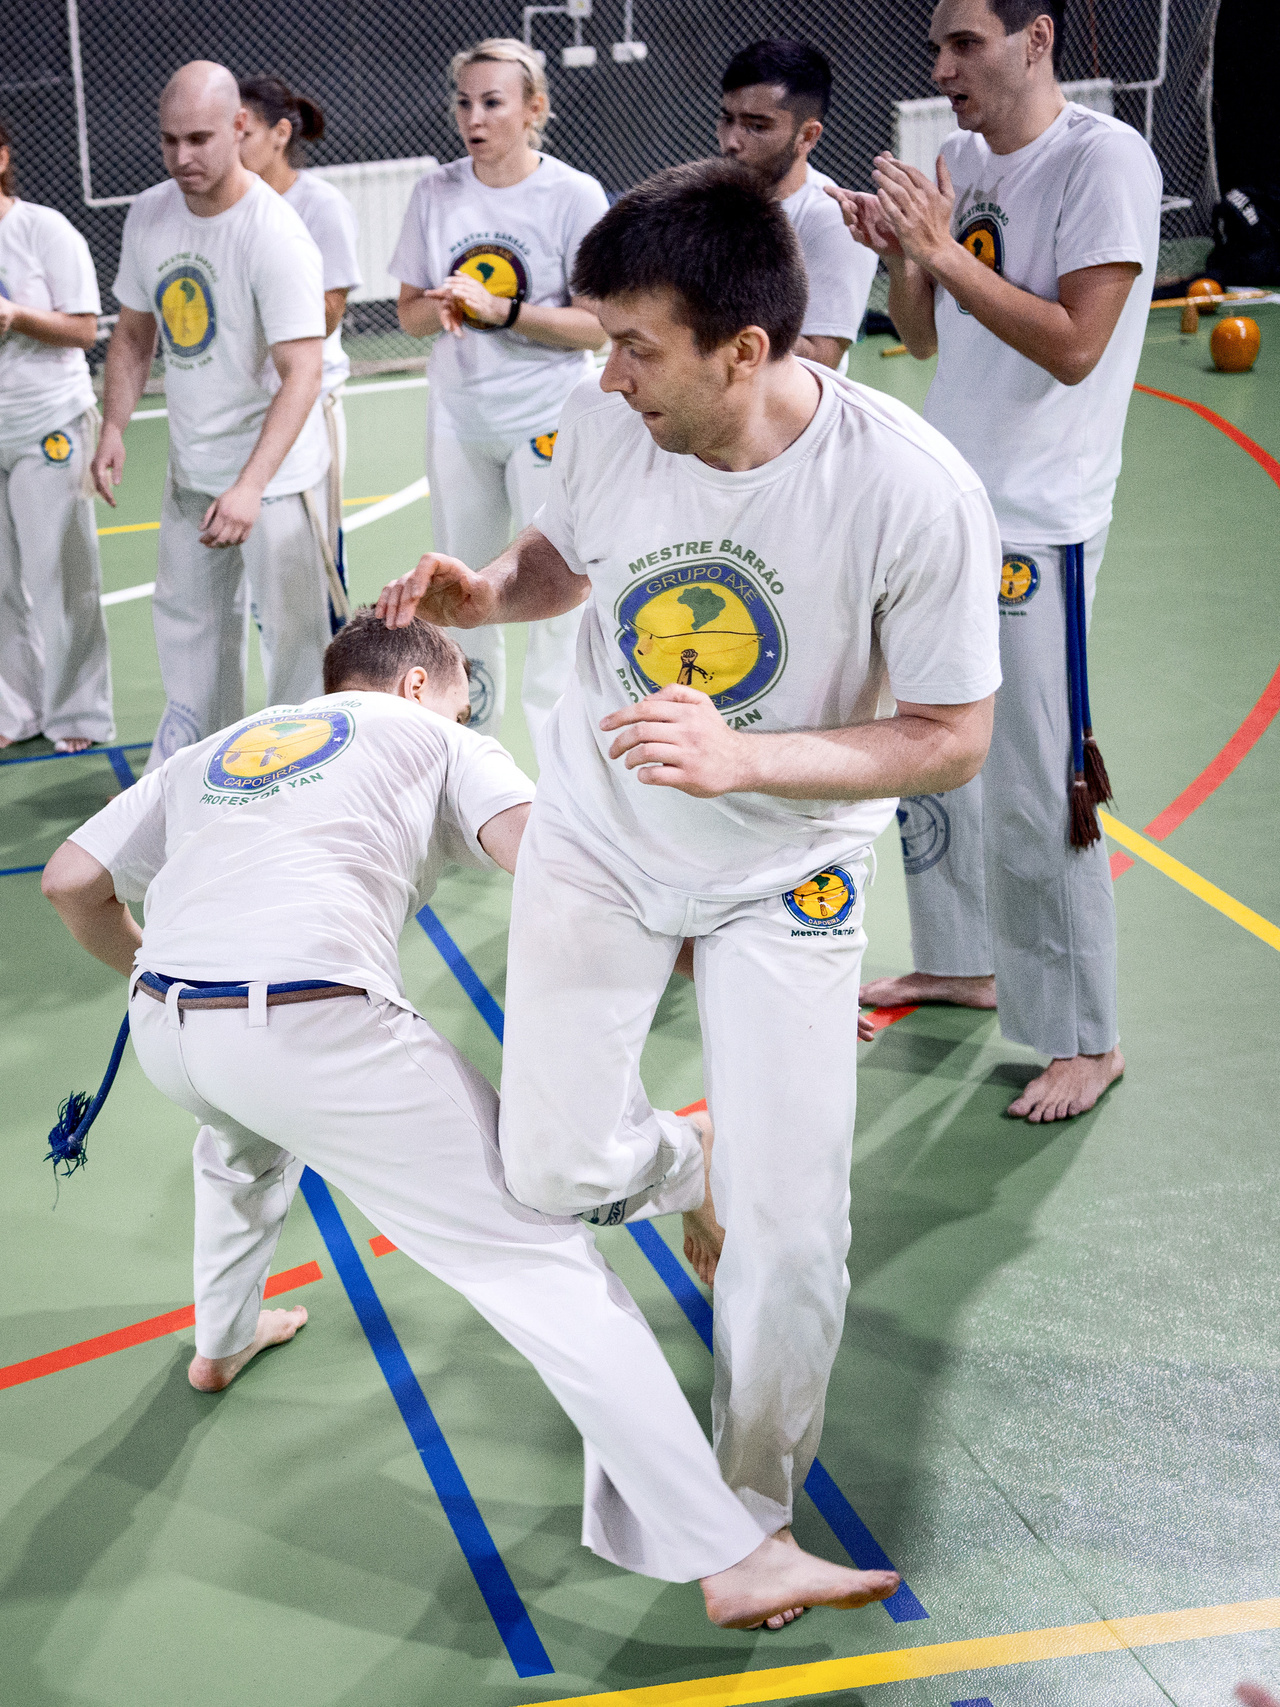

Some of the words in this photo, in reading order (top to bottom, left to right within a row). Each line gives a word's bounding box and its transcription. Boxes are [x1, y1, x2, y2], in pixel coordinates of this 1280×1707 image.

[628, 540, 713, 575] MESTRE
[719, 538, 785, 596] BARRÃO
[645, 566, 722, 595] GRUPO
[723, 573, 758, 606] AXÉ
[223, 763, 301, 788] CAPOEIRA
[286, 771, 324, 789] YAN
